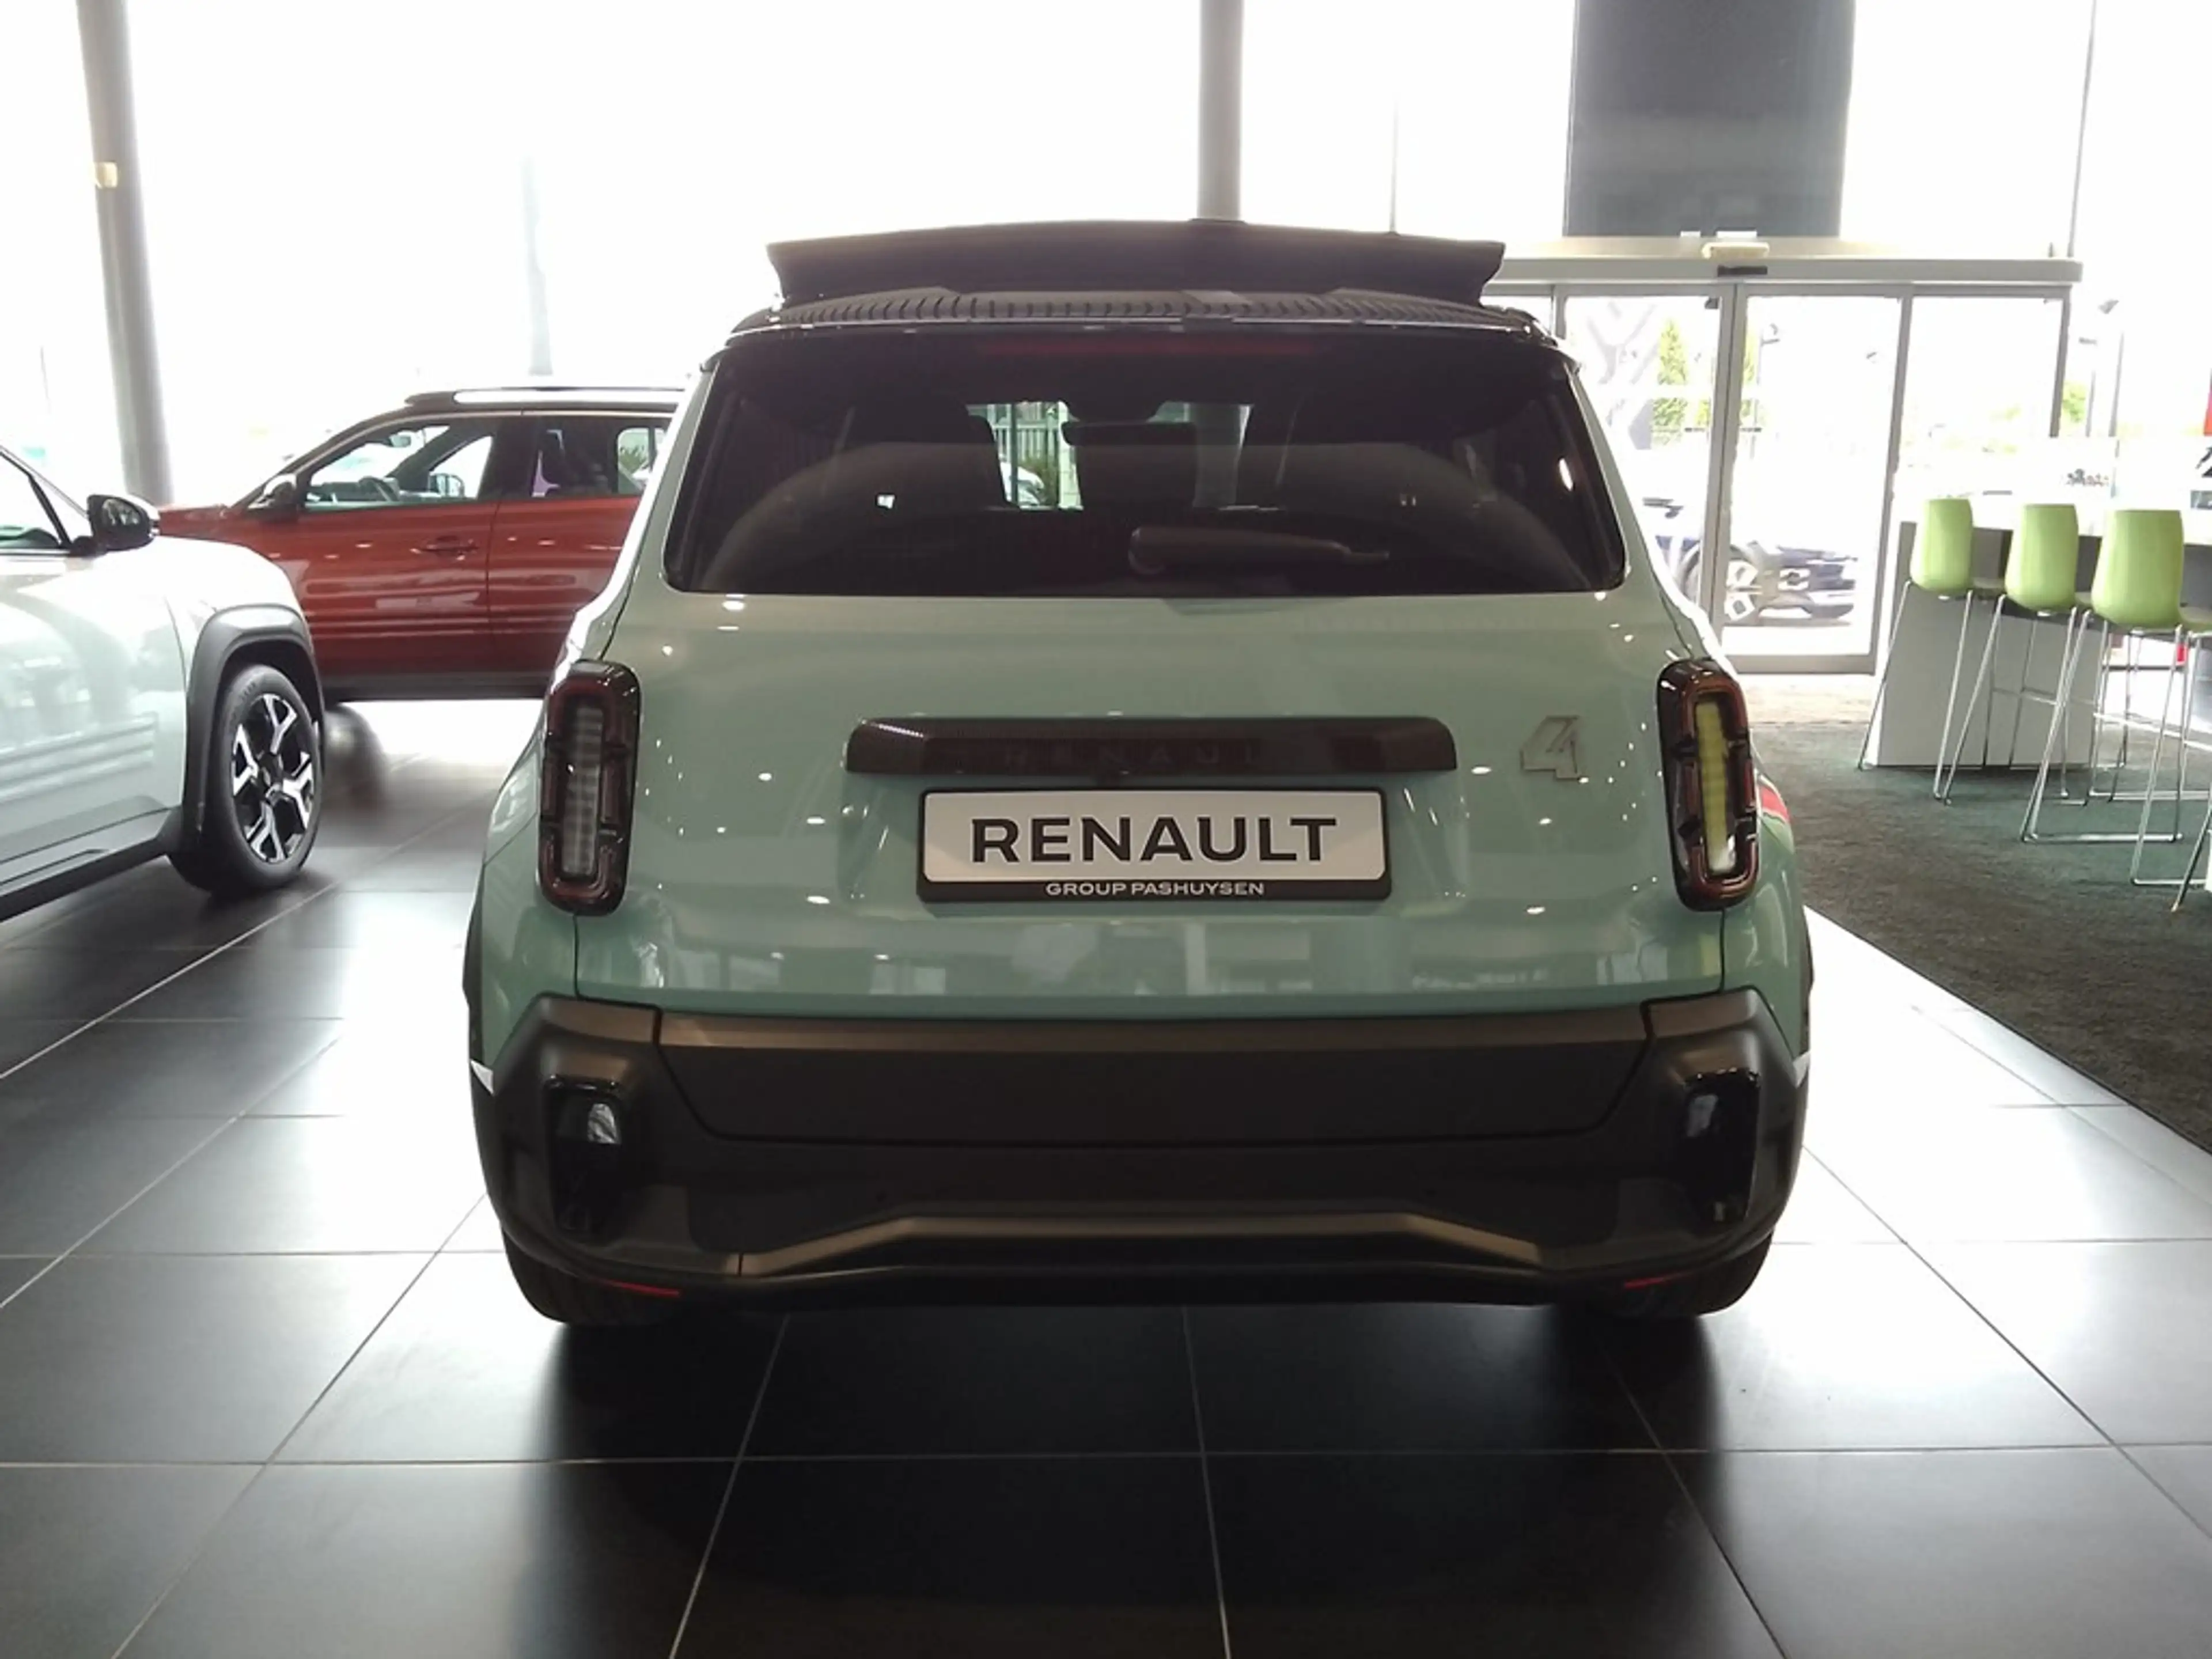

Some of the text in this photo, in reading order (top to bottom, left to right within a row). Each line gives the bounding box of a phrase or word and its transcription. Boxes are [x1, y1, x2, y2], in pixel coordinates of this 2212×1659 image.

[971, 816, 1338, 863] RENAULT
[1045, 882, 1265, 896] GROUP PASHUYSEN
